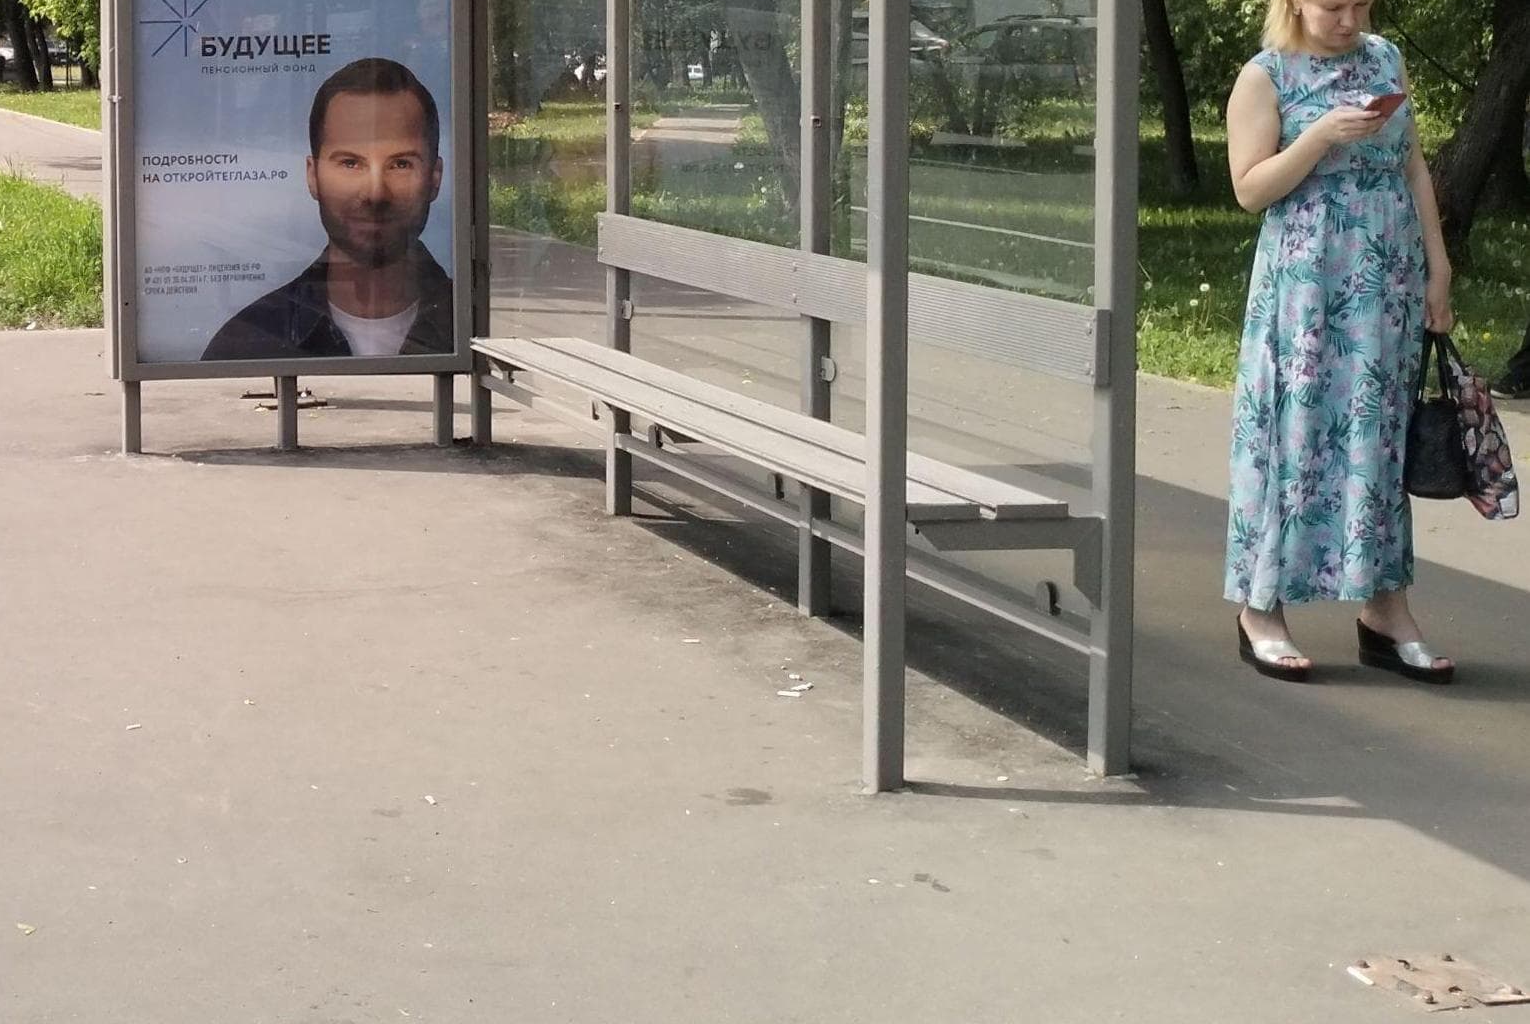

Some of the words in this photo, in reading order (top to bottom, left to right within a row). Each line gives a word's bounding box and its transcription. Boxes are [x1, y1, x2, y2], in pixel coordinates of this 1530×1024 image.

[201, 33, 331, 60] БУДУЩЕЕ
[201, 62, 279, 75] ПЕНСИОННЫЙ
[283, 64, 316, 74] ФОНД
[143, 154, 238, 167] ПОДРОБНОСТИ
[143, 174, 160, 183] НА
[163, 170, 289, 183] ОТКРОЙТЕГЛАЗА.РФ
